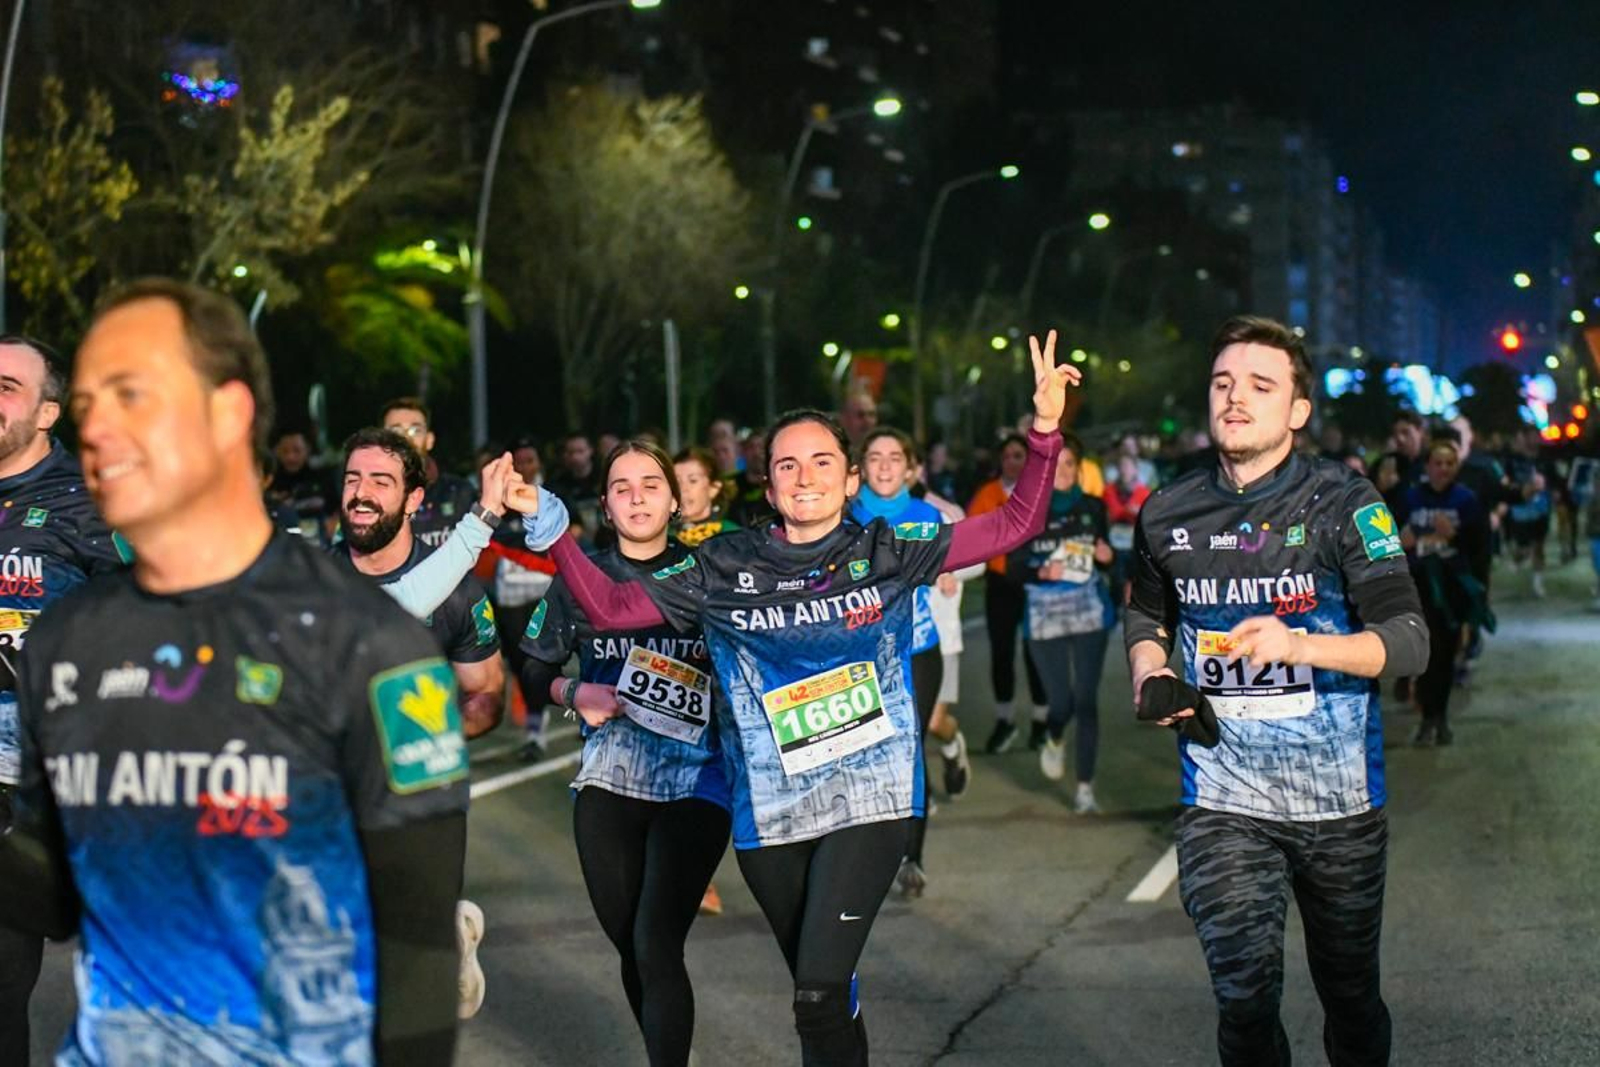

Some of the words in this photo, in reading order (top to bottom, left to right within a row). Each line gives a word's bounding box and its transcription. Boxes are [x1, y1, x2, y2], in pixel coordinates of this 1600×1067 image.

[1174, 577, 1218, 605] SAN
[1225, 568, 1316, 605] ANTÓN
[731, 605, 785, 632] SAN
[793, 586, 883, 627] ANTÓN
[844, 602, 885, 630] 2025
[1273, 588, 1319, 616] 2025
[593, 637, 635, 660] SAN
[650, 656, 669, 673] 42
[1203, 657, 1296, 687] 9121
[628, 670, 703, 716] 9538
[788, 685, 810, 702] 42
[781, 684, 873, 739] 1660
[45, 752, 99, 807] AN
[107, 738, 289, 811] ANTÓN
